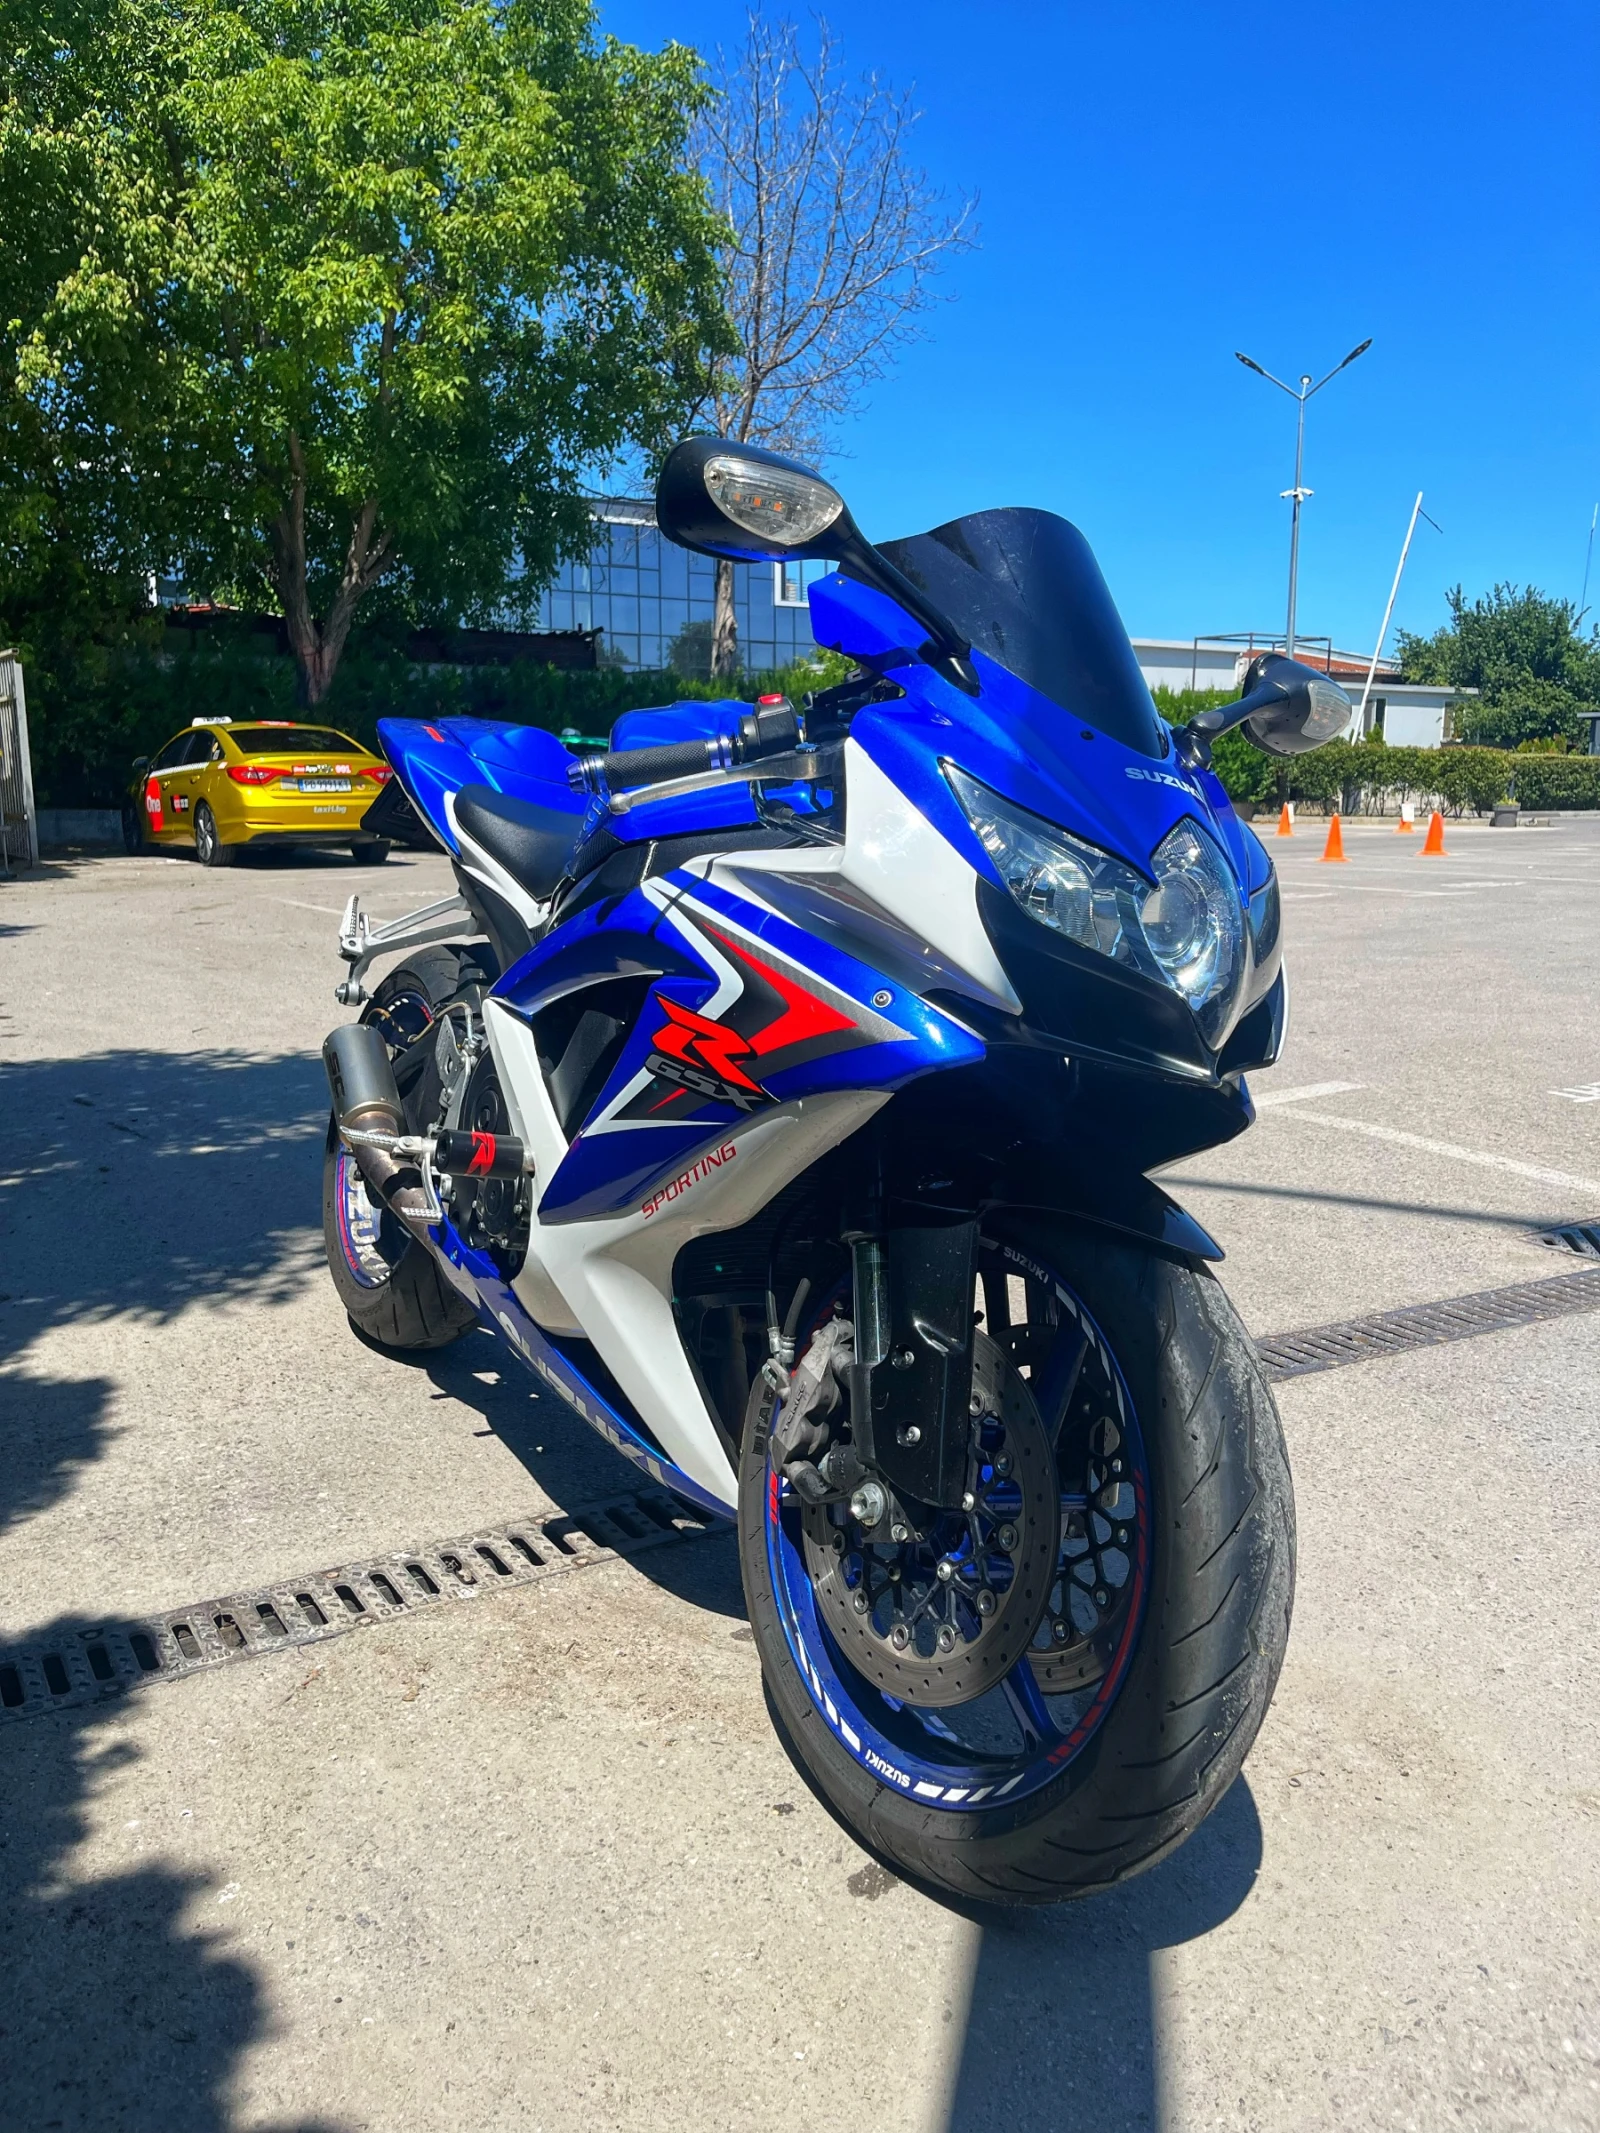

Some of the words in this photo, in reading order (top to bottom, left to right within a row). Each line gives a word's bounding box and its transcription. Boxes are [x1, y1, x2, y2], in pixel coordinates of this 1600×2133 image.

[146, 795, 162, 813] One
[645, 1053, 763, 1111] GSX
[640, 1139, 738, 1220] SPORTING
[347, 1160, 391, 1273] UZUKI
[1003, 1246, 1049, 1284] SUZUKI
[864, 1748, 911, 1789] SUZUKI
